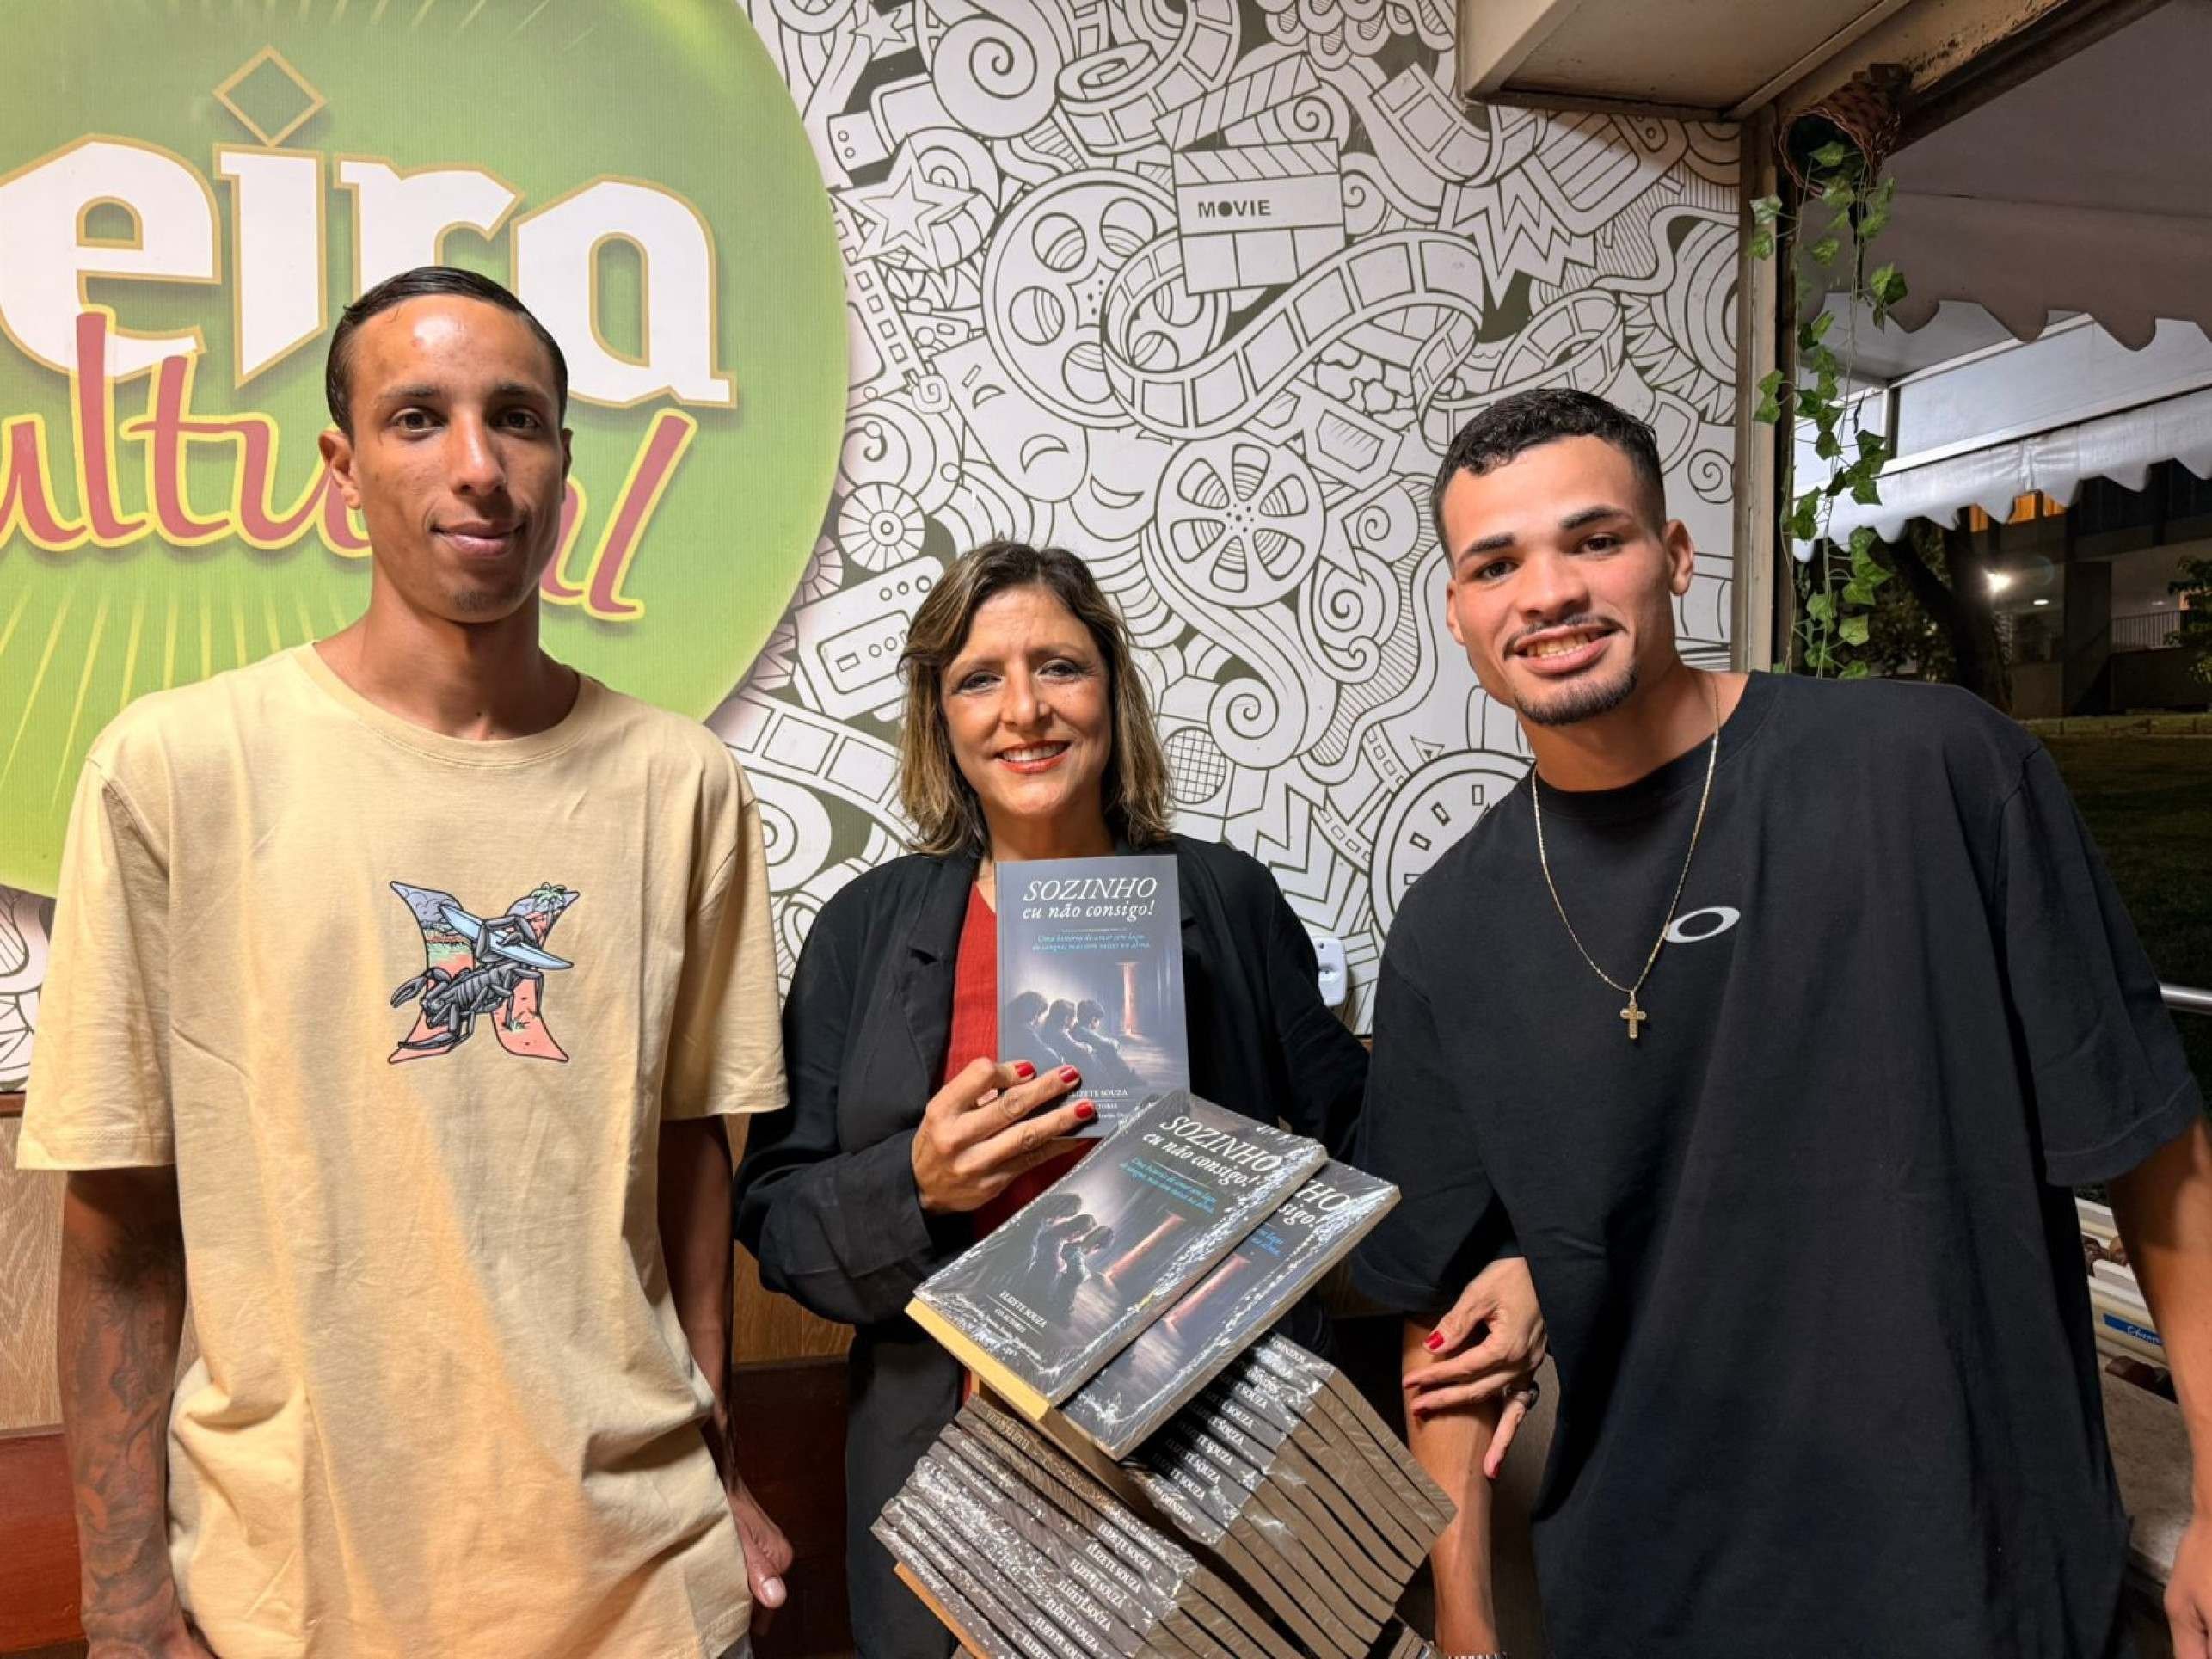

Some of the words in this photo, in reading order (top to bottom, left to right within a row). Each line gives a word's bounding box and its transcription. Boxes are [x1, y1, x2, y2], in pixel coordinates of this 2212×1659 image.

[1198, 200, 1271, 218] MOVIE
[1023, 877, 1158, 901] SOZINHO
[1023, 907, 1041, 919] eu
[1048, 904, 1081, 918] não
[1086, 900, 1155, 922] consigo!
[1101, 1088, 1128, 1097] SOUZA
[1159, 1116, 1283, 1172] SOZINHO
[1278, 1203, 1330, 1228] sigo!
[1128, 1547, 1152, 1571] SOUZA
[1117, 1567, 1141, 1594] SOUZA
